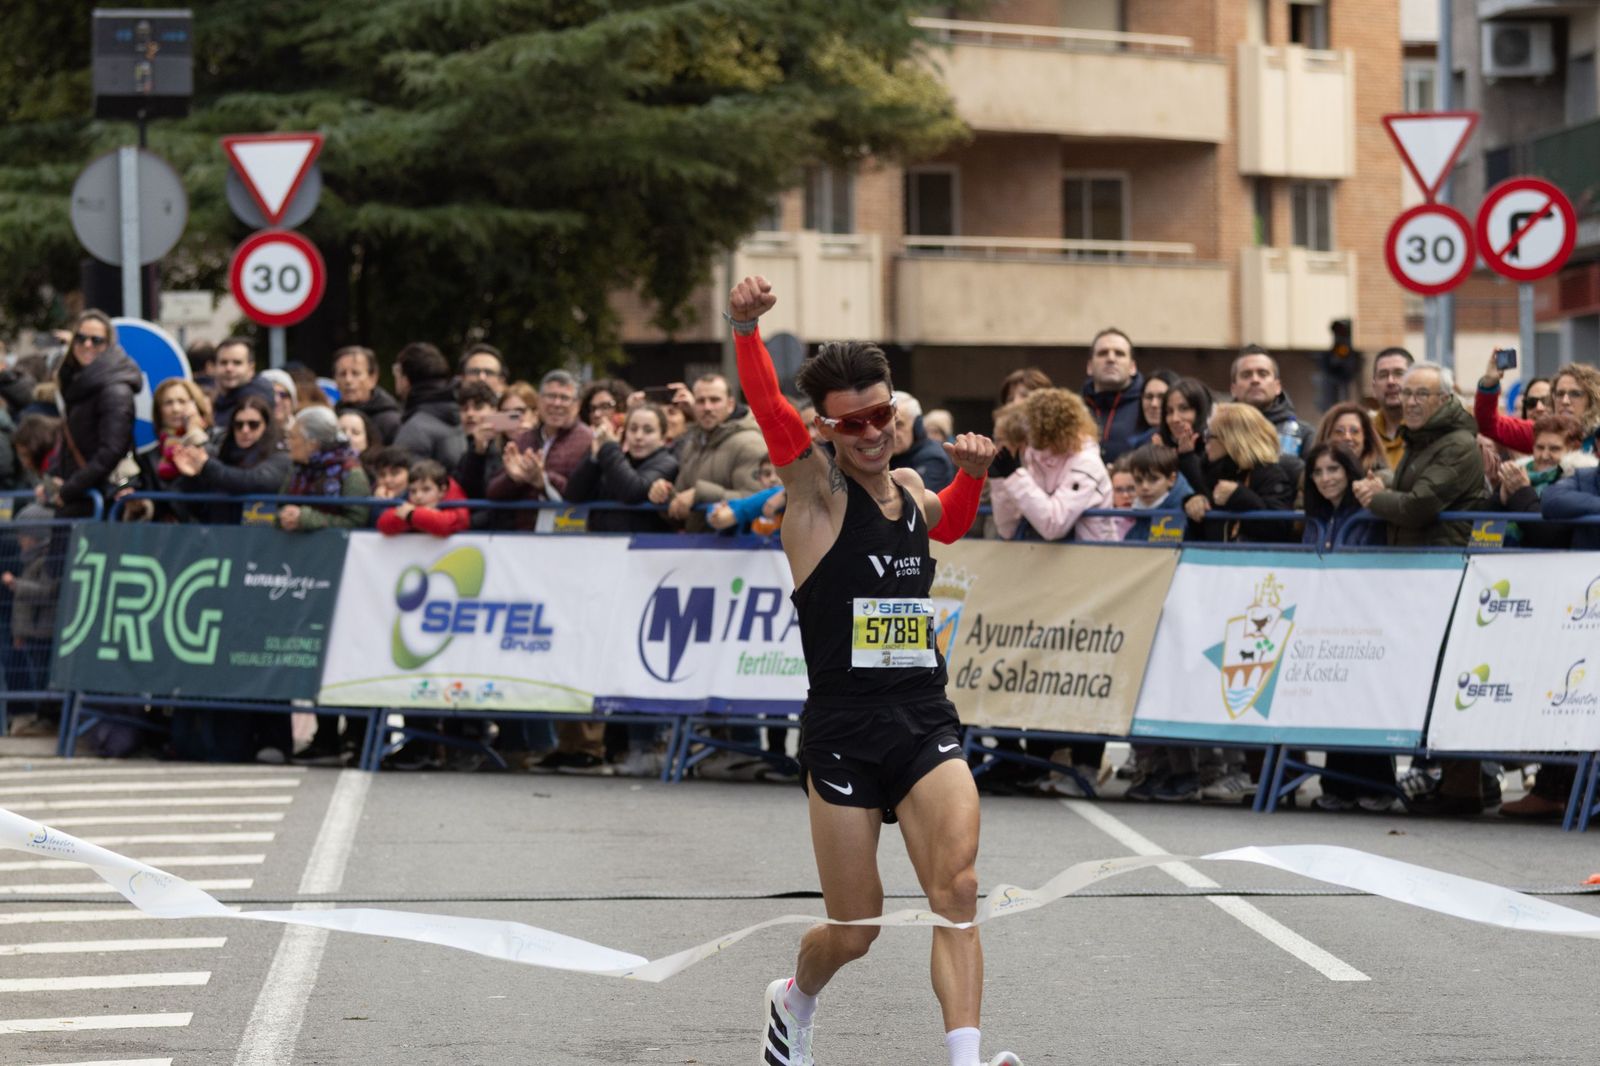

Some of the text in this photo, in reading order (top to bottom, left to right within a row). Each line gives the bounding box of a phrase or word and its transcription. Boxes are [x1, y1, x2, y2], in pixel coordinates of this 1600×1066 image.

[1406, 235, 1455, 264] 30
[252, 264, 301, 294] 30
[893, 556, 921, 569] VICKY
[896, 567, 920, 578] FOODS
[879, 603, 929, 614] SETEL
[1488, 599, 1533, 613] SETEL
[421, 601, 553, 635] SETEL
[866, 617, 919, 644] 5789
[965, 613, 1125, 654] Ayuntamiento
[500, 636, 551, 652] Grupo
[1290, 639, 1386, 661] San Estanislao
[955, 657, 1114, 699] de Salamanca
[1284, 662, 1350, 683] de Kostka
[1466, 683, 1513, 697] SETEL
